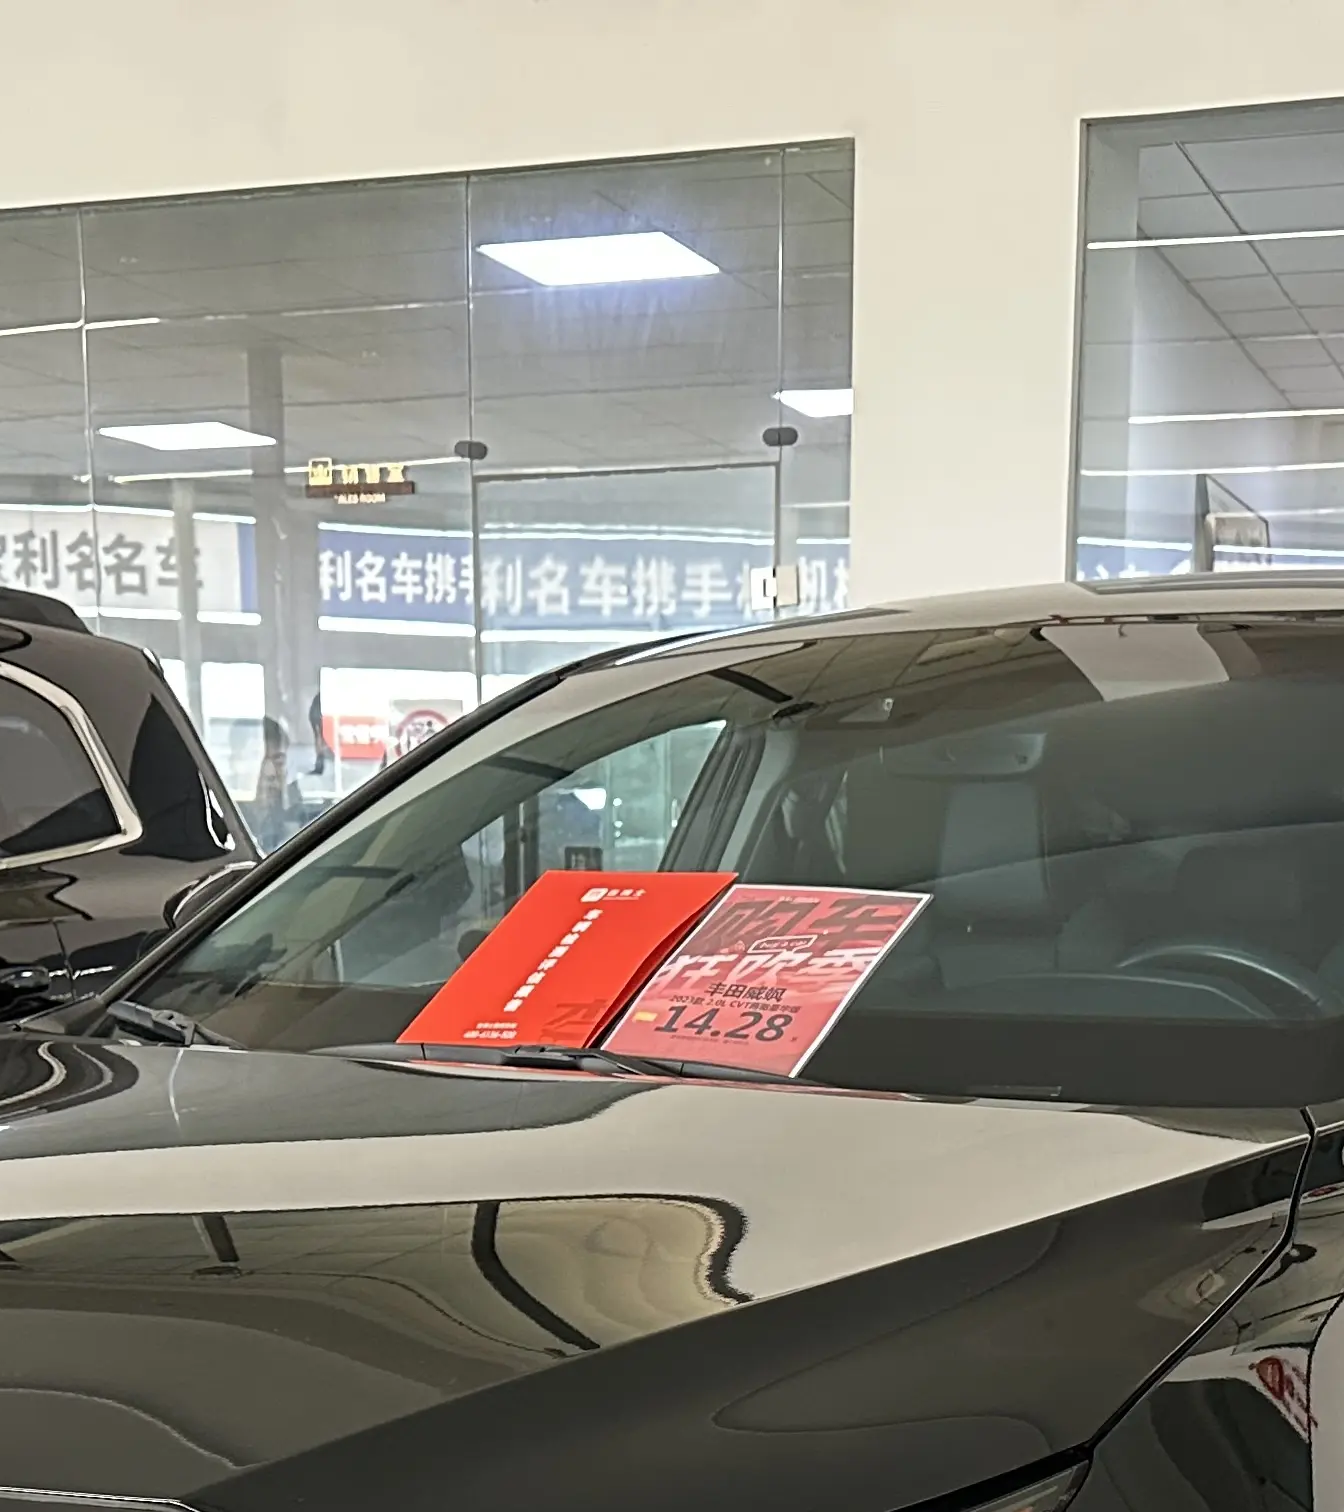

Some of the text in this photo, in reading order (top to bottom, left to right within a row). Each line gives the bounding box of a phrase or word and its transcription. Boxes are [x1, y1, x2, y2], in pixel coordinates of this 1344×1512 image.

[703, 982, 787, 1002] 丰田威飒
[654, 1005, 793, 1042] 14.28
